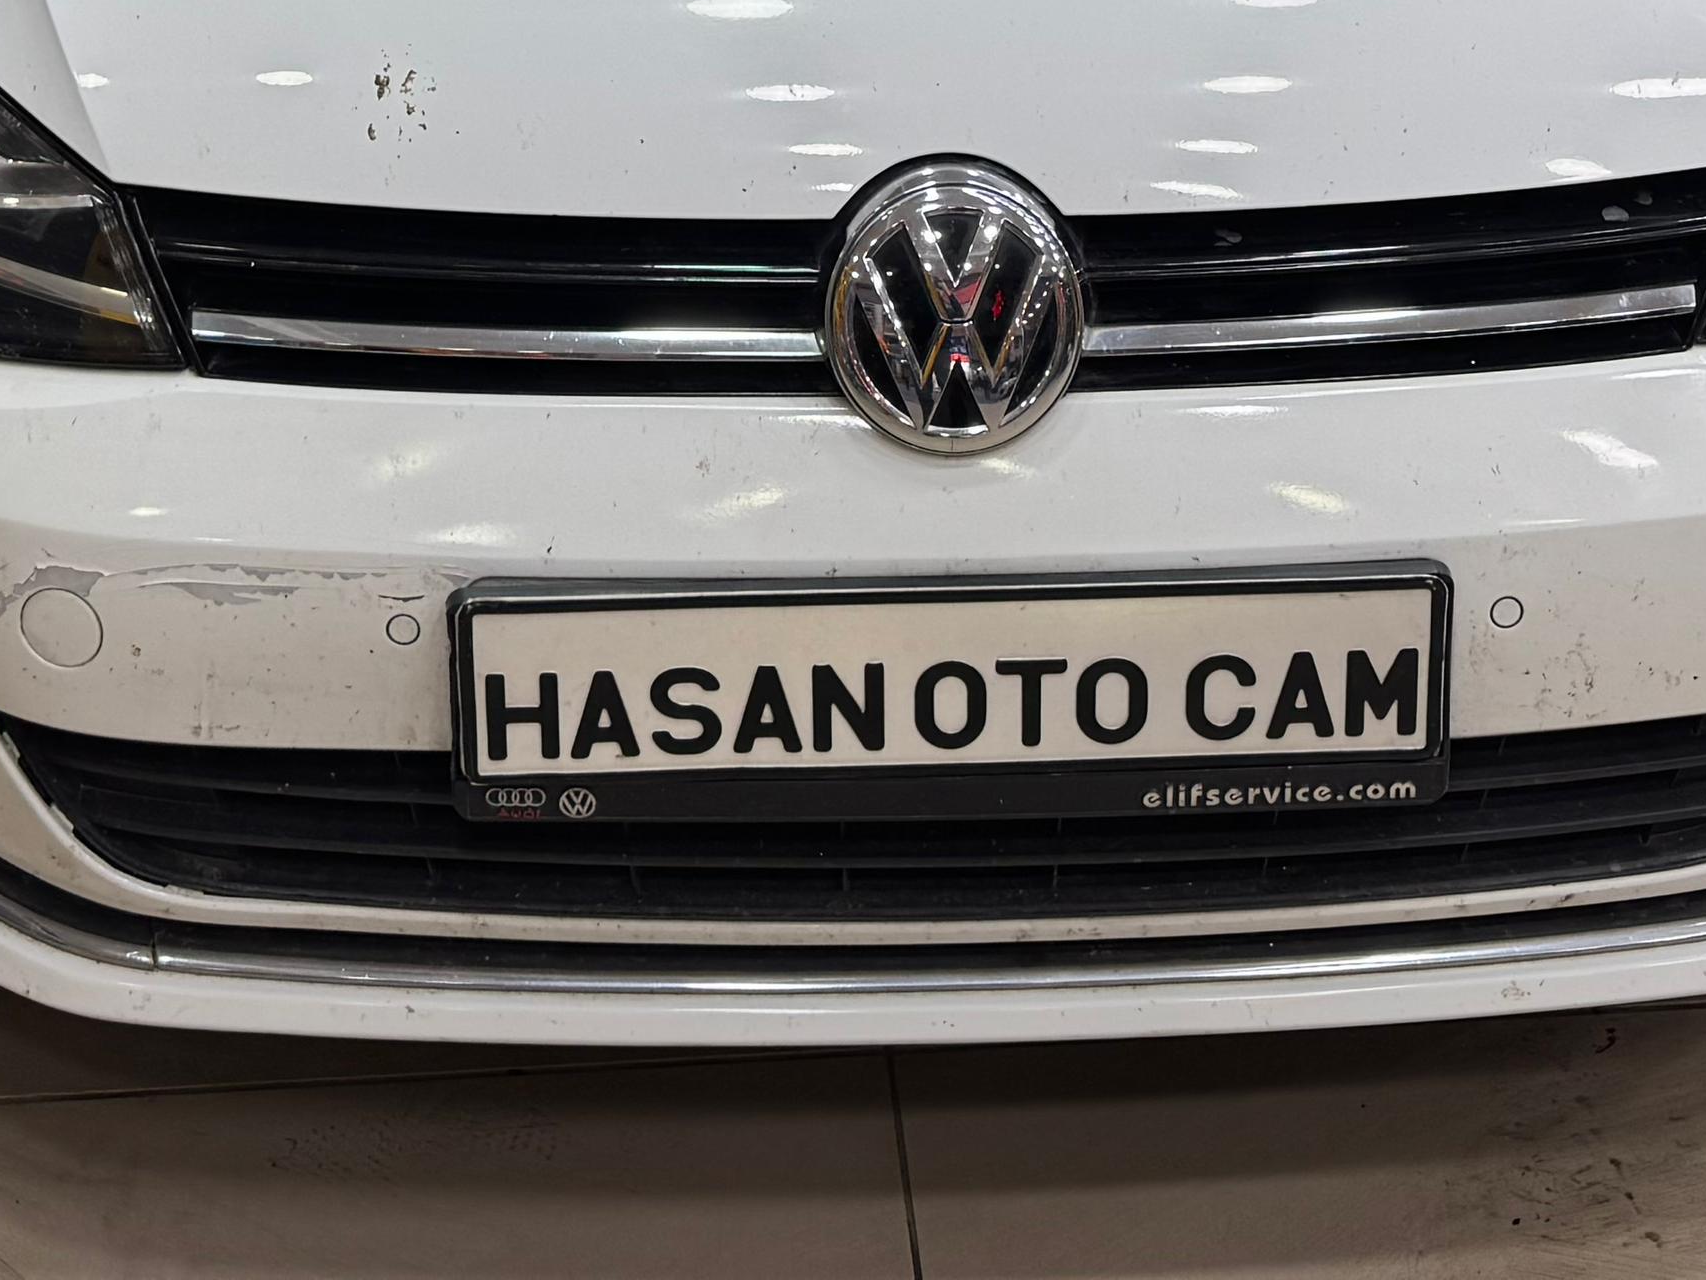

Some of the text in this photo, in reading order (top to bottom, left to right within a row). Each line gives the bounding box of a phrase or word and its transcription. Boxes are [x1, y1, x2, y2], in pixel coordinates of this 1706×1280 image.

[485, 647, 1420, 761] HASAN OTO CAM
[1140, 777, 1418, 810] elifservice.com
